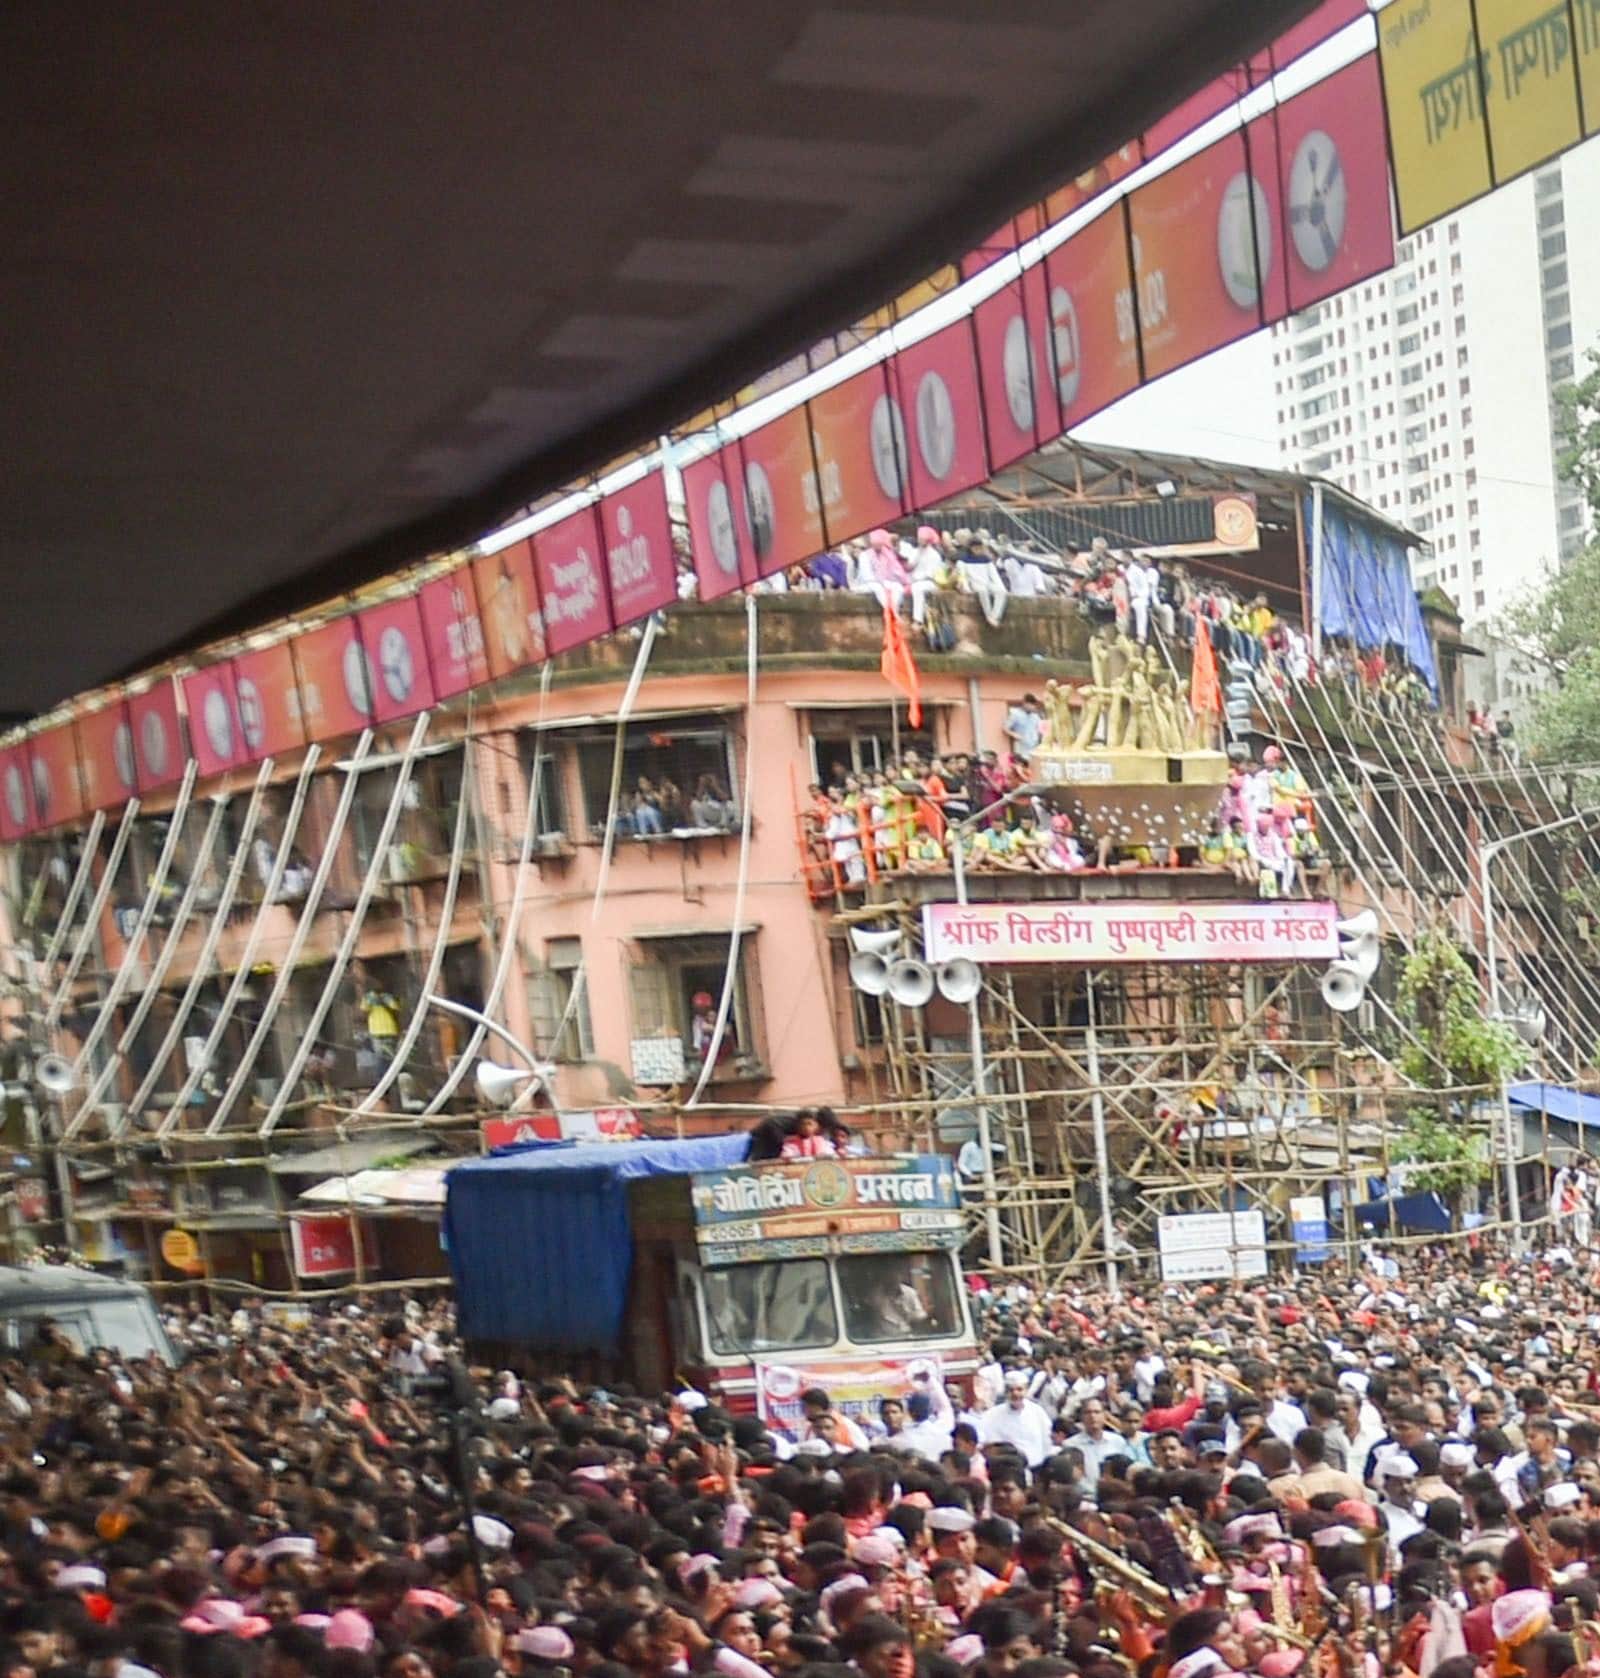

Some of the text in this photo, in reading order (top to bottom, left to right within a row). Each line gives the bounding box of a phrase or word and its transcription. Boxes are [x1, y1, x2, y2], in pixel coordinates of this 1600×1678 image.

[942, 913, 999, 946] श्रॉफ
[1204, 918, 1264, 944] उत्सव
[1273, 908, 1329, 941] मंडळ
